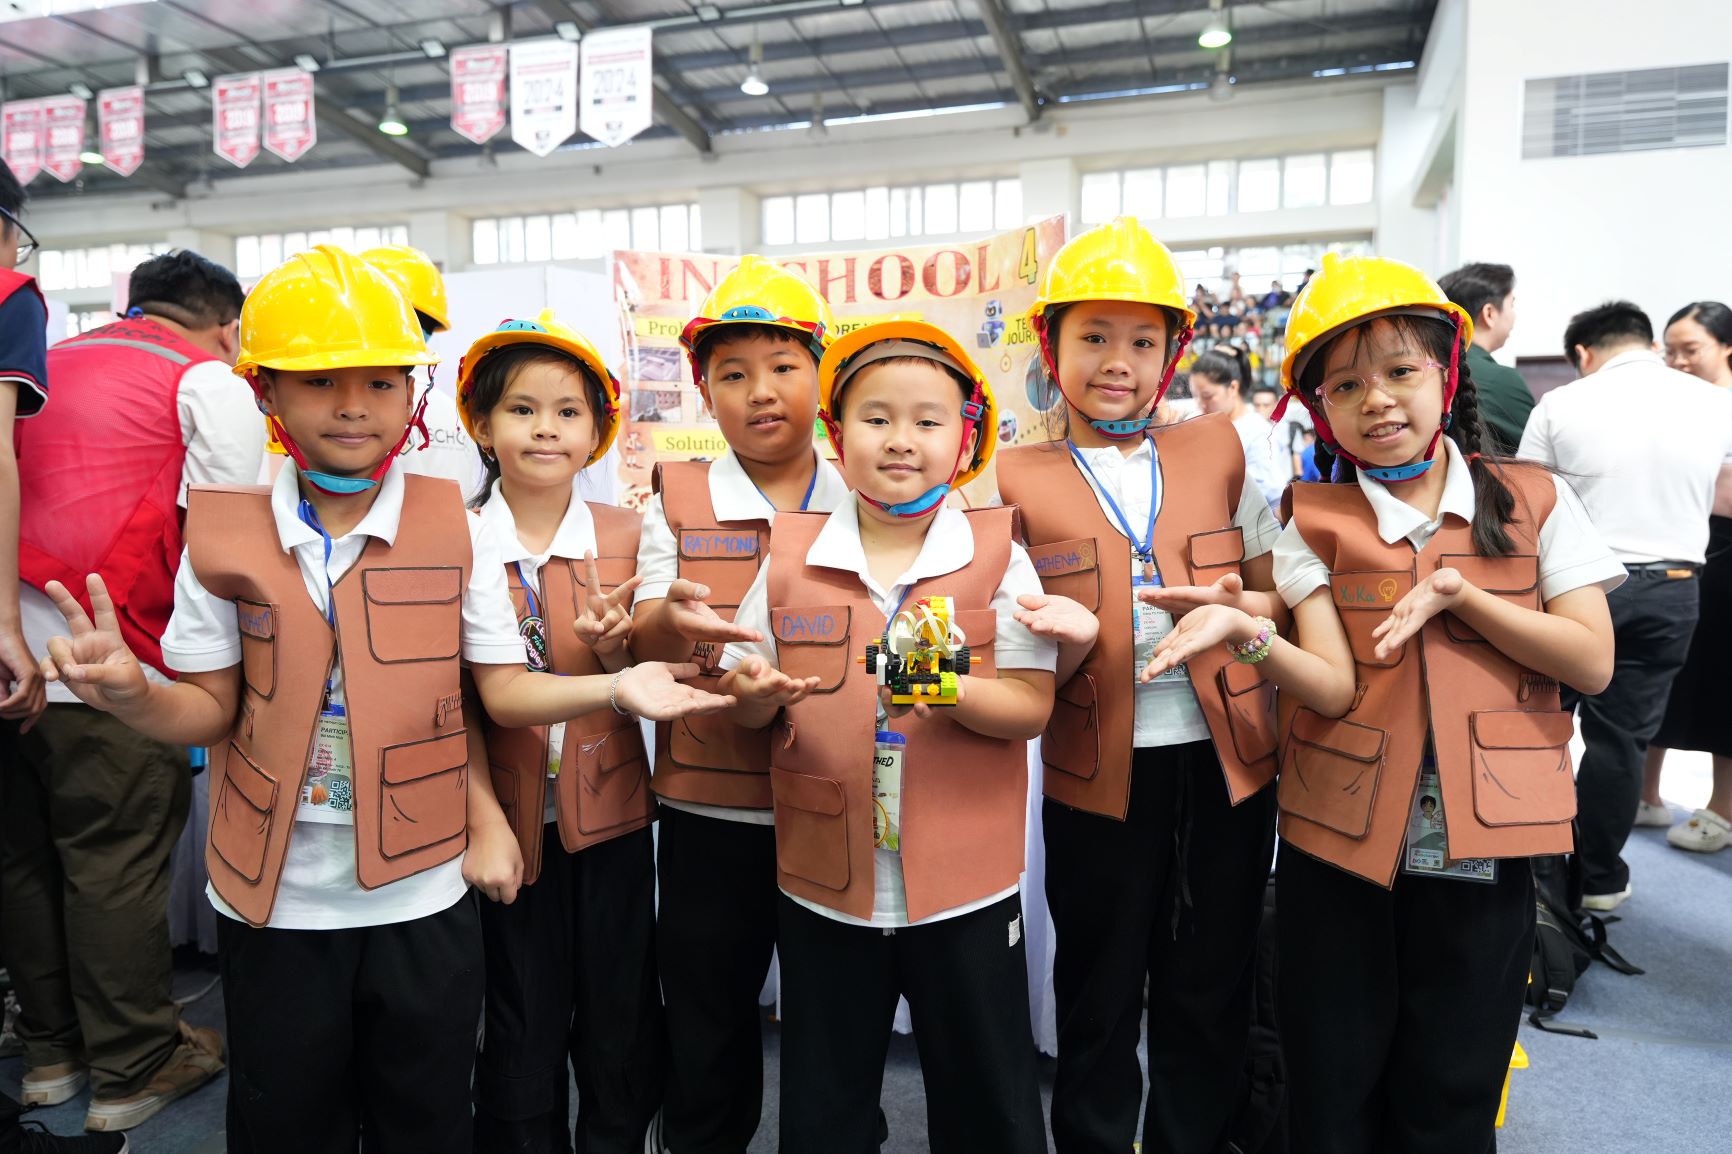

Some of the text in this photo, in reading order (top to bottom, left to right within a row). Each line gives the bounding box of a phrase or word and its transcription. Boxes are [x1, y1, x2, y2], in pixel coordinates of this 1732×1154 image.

[1019, 227, 1038, 284] 4
[684, 535, 759, 554] RAYMOND
[1035, 551, 1081, 571] ATHENA
[781, 614, 835, 639] DAVID
